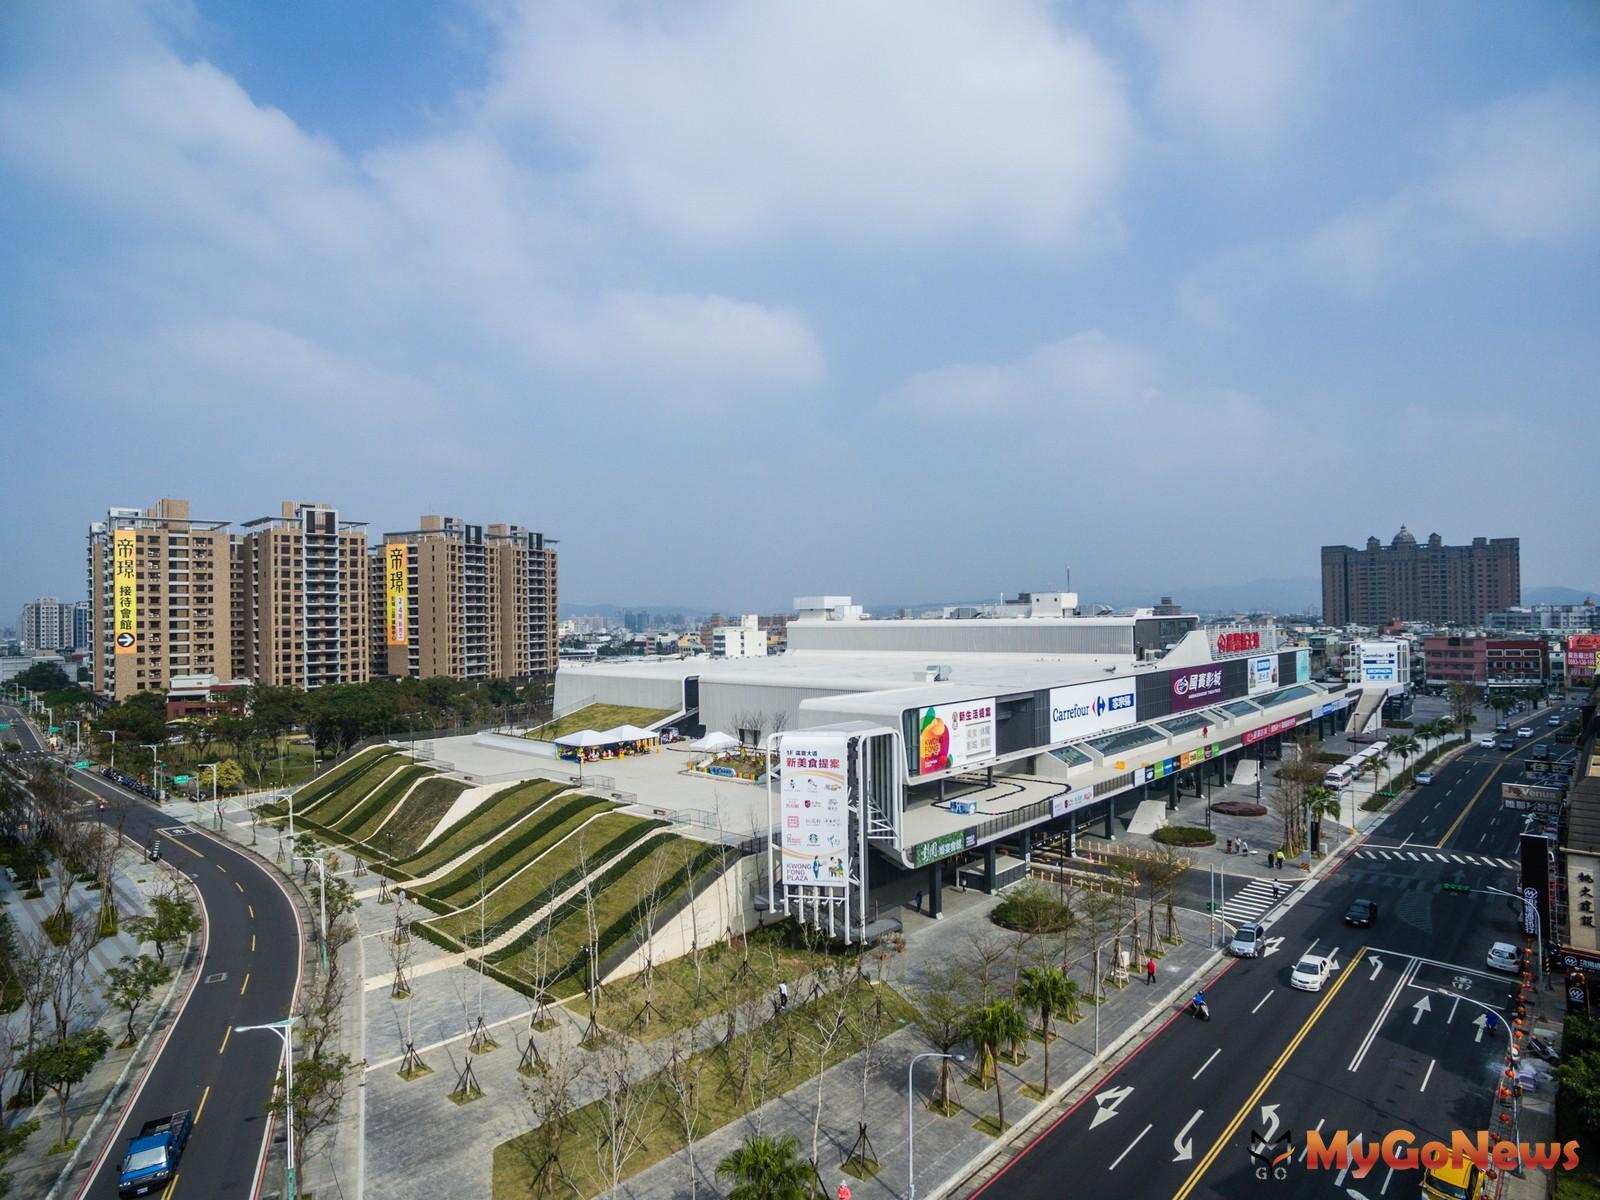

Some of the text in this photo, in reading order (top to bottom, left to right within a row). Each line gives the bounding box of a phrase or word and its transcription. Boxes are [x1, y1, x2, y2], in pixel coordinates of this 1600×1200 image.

[390, 547, 404, 593] 帝璟
[117, 538, 134, 630] 帝璟 接待會館
[1189, 670, 1221, 690] 國賓影城
[959, 707, 991, 721] 新生活提案
[1053, 704, 1089, 722] Carrefour
[786, 757, 840, 768] 新美食提案
